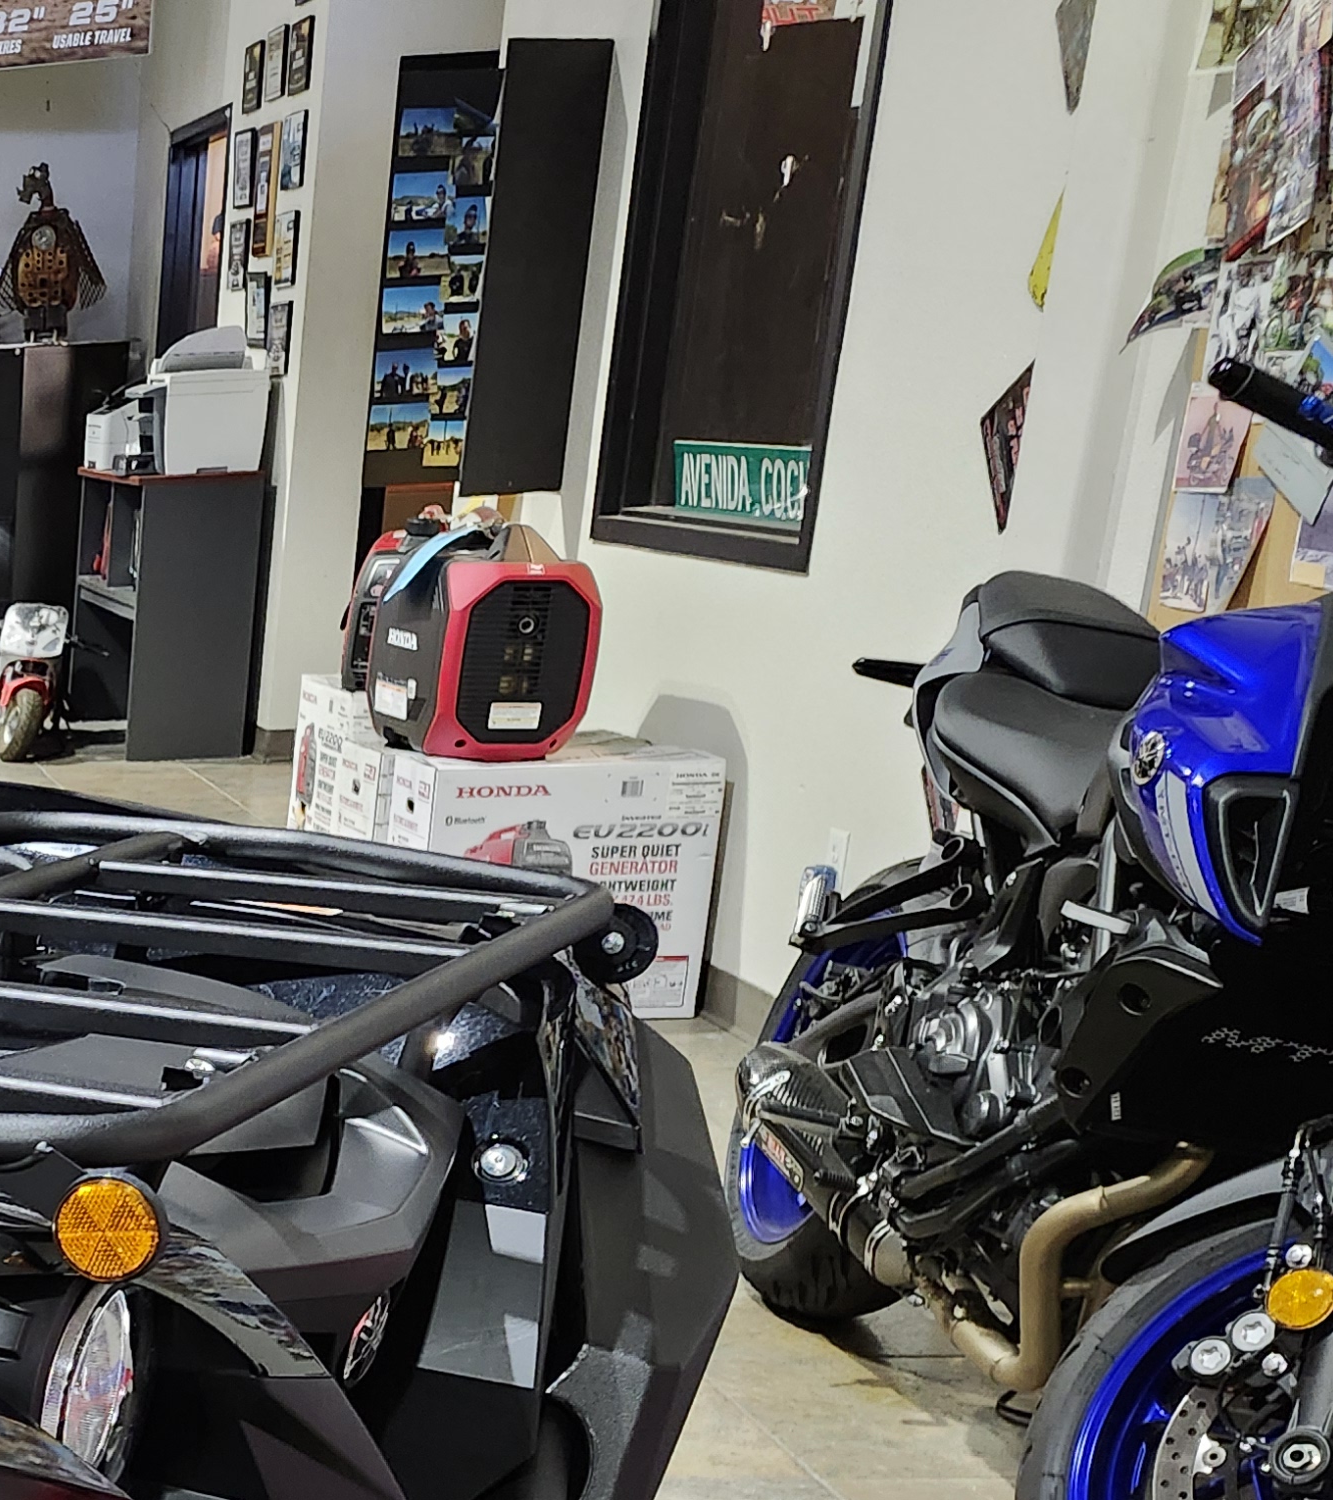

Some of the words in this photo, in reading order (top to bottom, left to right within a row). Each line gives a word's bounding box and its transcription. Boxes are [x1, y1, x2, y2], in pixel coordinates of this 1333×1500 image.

[68, 0, 132, 26] 25"
[52, 33, 91, 49] USABLE
[92, 27, 132, 46] TRAVEL
[680, 451, 752, 513] AVENIDA
[387, 627, 419, 651] HONDA
[455, 784, 551, 799] HONDA
[573, 822, 711, 840] EU2200i
[591, 845, 637, 859] SUPER
[642, 843, 682, 858] QUIET
[589, 860, 678, 876] GENERATOR
